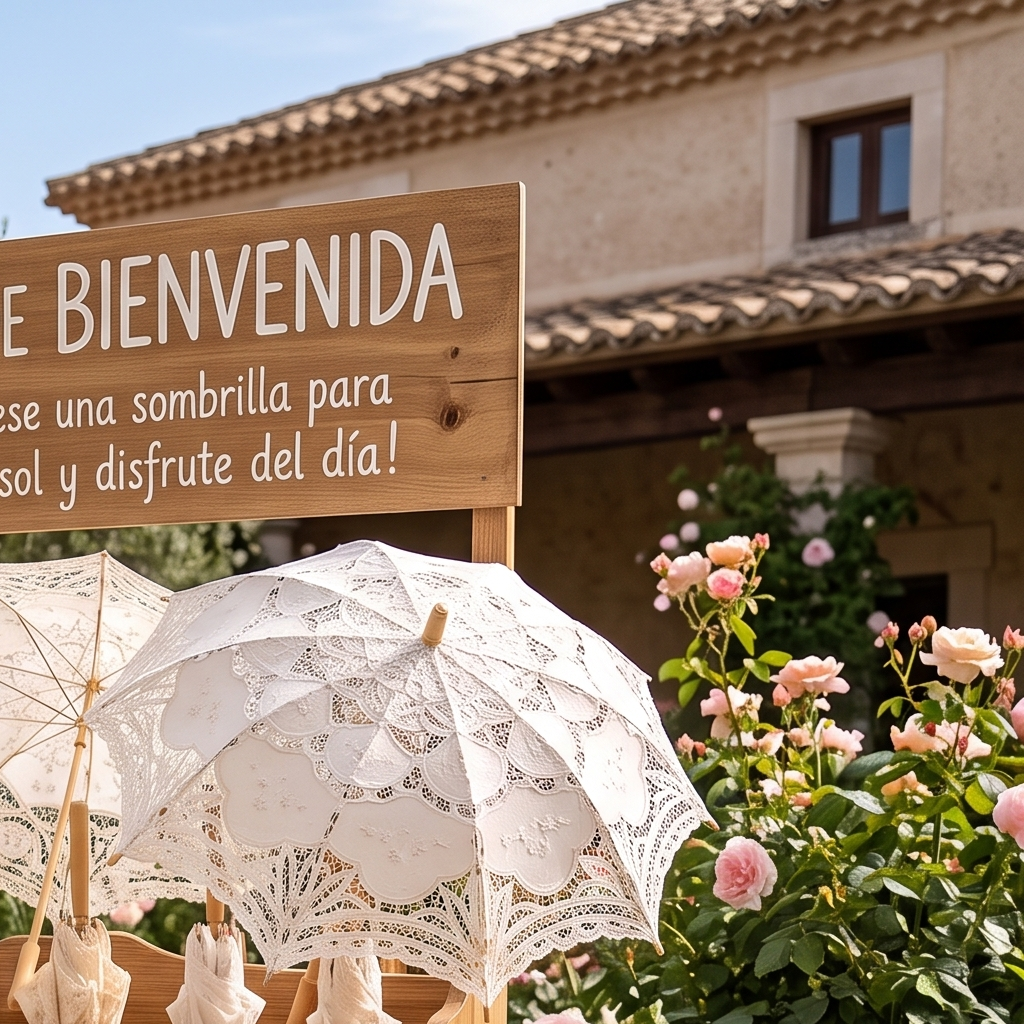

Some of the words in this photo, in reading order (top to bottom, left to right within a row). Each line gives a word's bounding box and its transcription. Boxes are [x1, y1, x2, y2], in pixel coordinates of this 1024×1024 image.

[57, 222, 464, 355] BIENVENIDA
[56, 395, 117, 429] una
[131, 365, 292, 424] sombrilla
[307, 373, 393, 428] para
[59, 463, 77, 512] y
[95, 440, 233, 505] disfrute
[250, 430, 305, 482] del
[321, 419, 398, 478] día!
